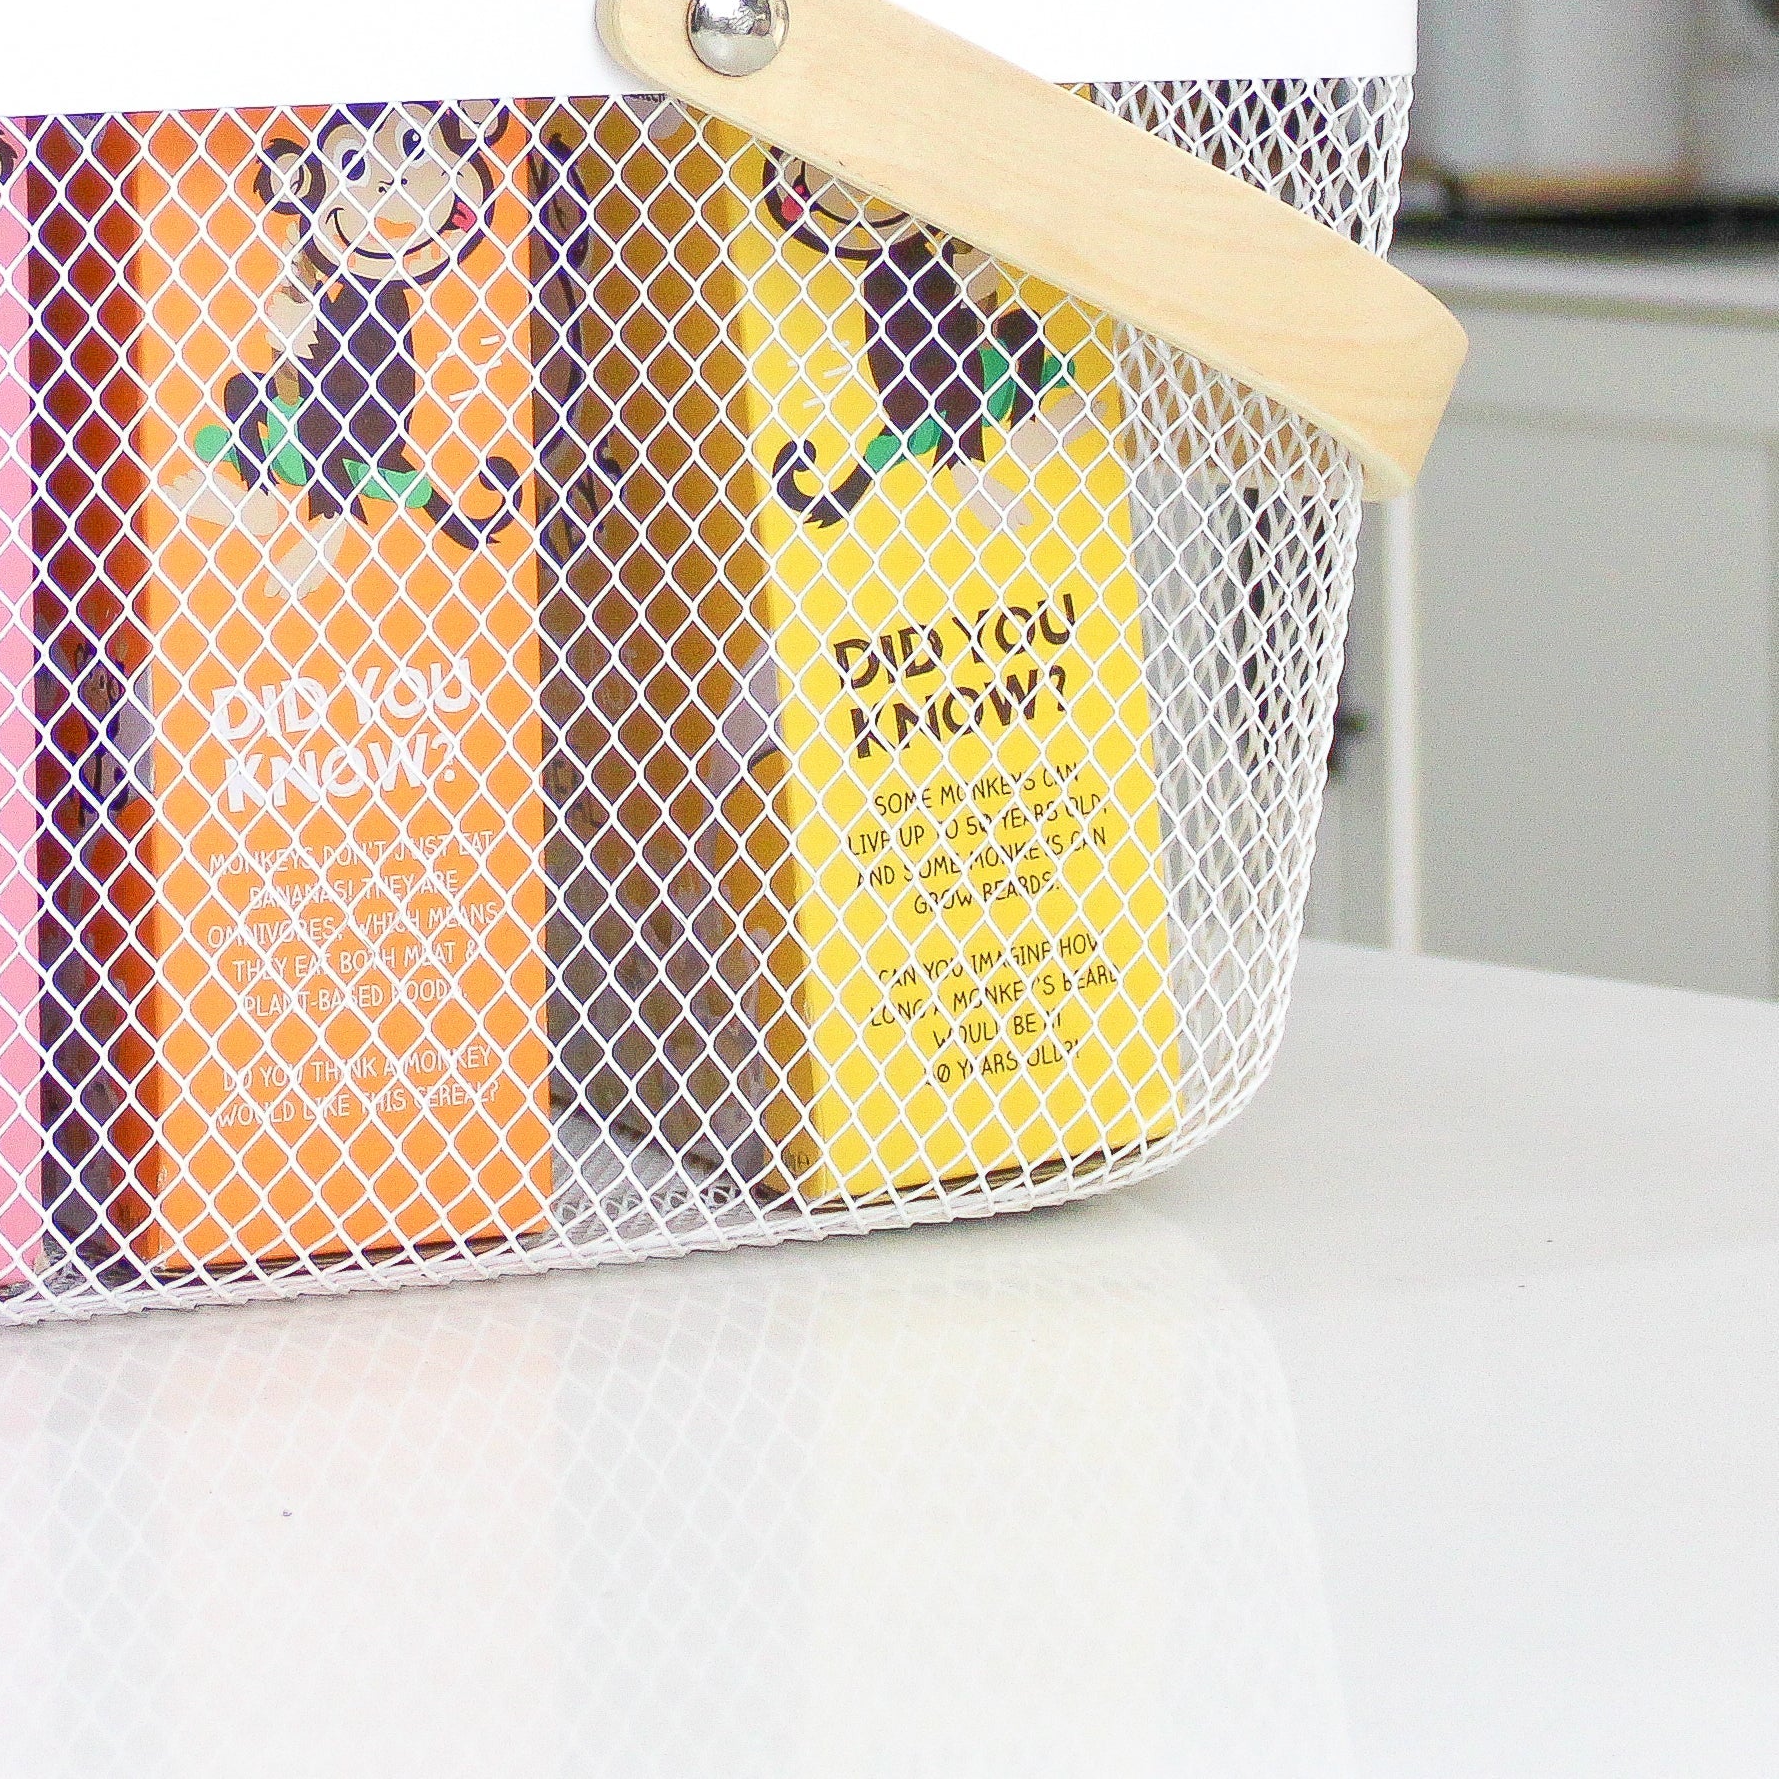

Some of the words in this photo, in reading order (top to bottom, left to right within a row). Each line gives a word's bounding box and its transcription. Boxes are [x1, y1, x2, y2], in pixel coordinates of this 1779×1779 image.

[834, 625, 943, 689] DID
[952, 594, 1075, 663] YOU
[211, 677, 328, 740] DID
[338, 657, 472, 724] YOU
[851, 665, 1066, 759] KNOW?
[224, 732, 456, 813] KNOW?
[875, 787, 932, 816] SOME
[899, 825, 925, 848] UP
[1013, 1013, 1037, 1036] BE
[310, 1056, 378, 1083] THNK
